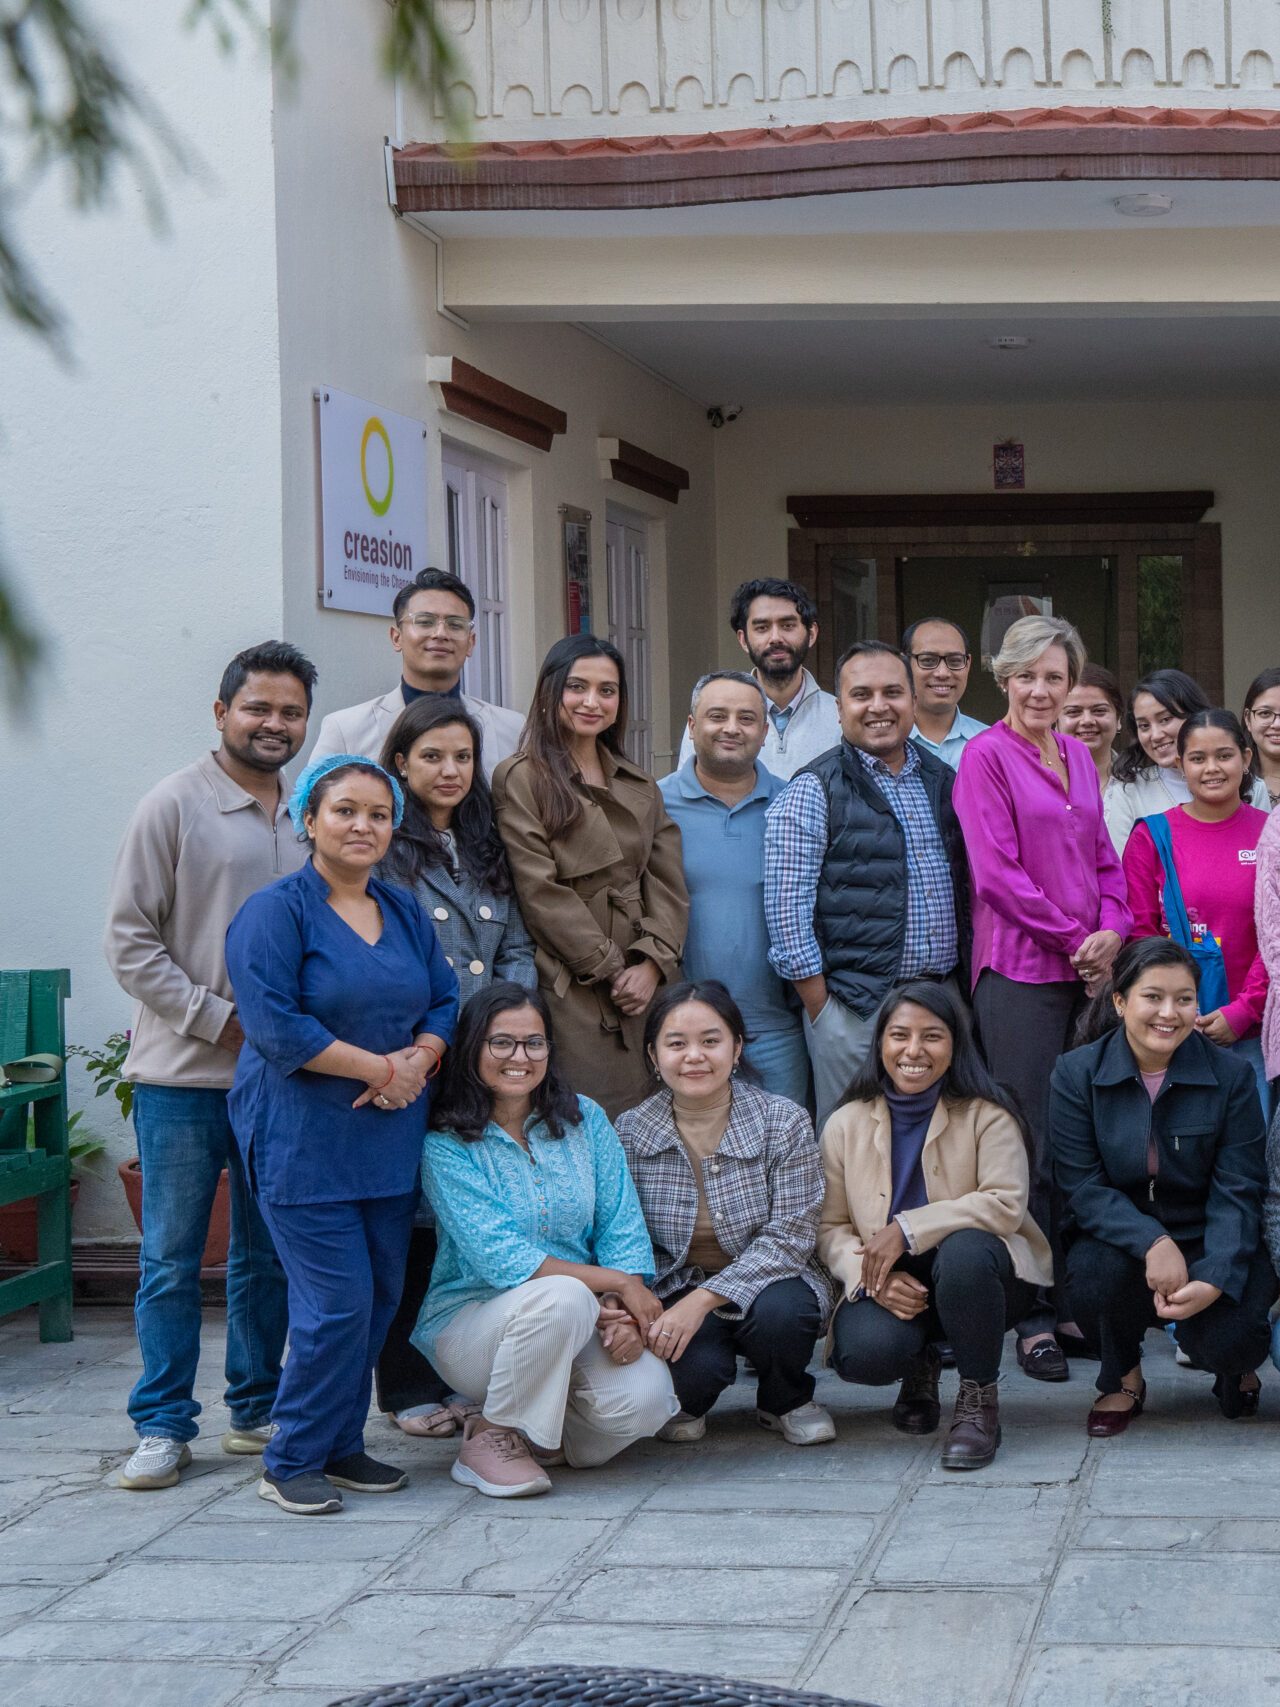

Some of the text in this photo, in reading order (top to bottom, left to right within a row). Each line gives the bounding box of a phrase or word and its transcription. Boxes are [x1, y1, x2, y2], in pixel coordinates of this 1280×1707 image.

[344, 530, 412, 571] creasion
[344, 565, 379, 588] Envisioning
[380, 571, 390, 588] the
